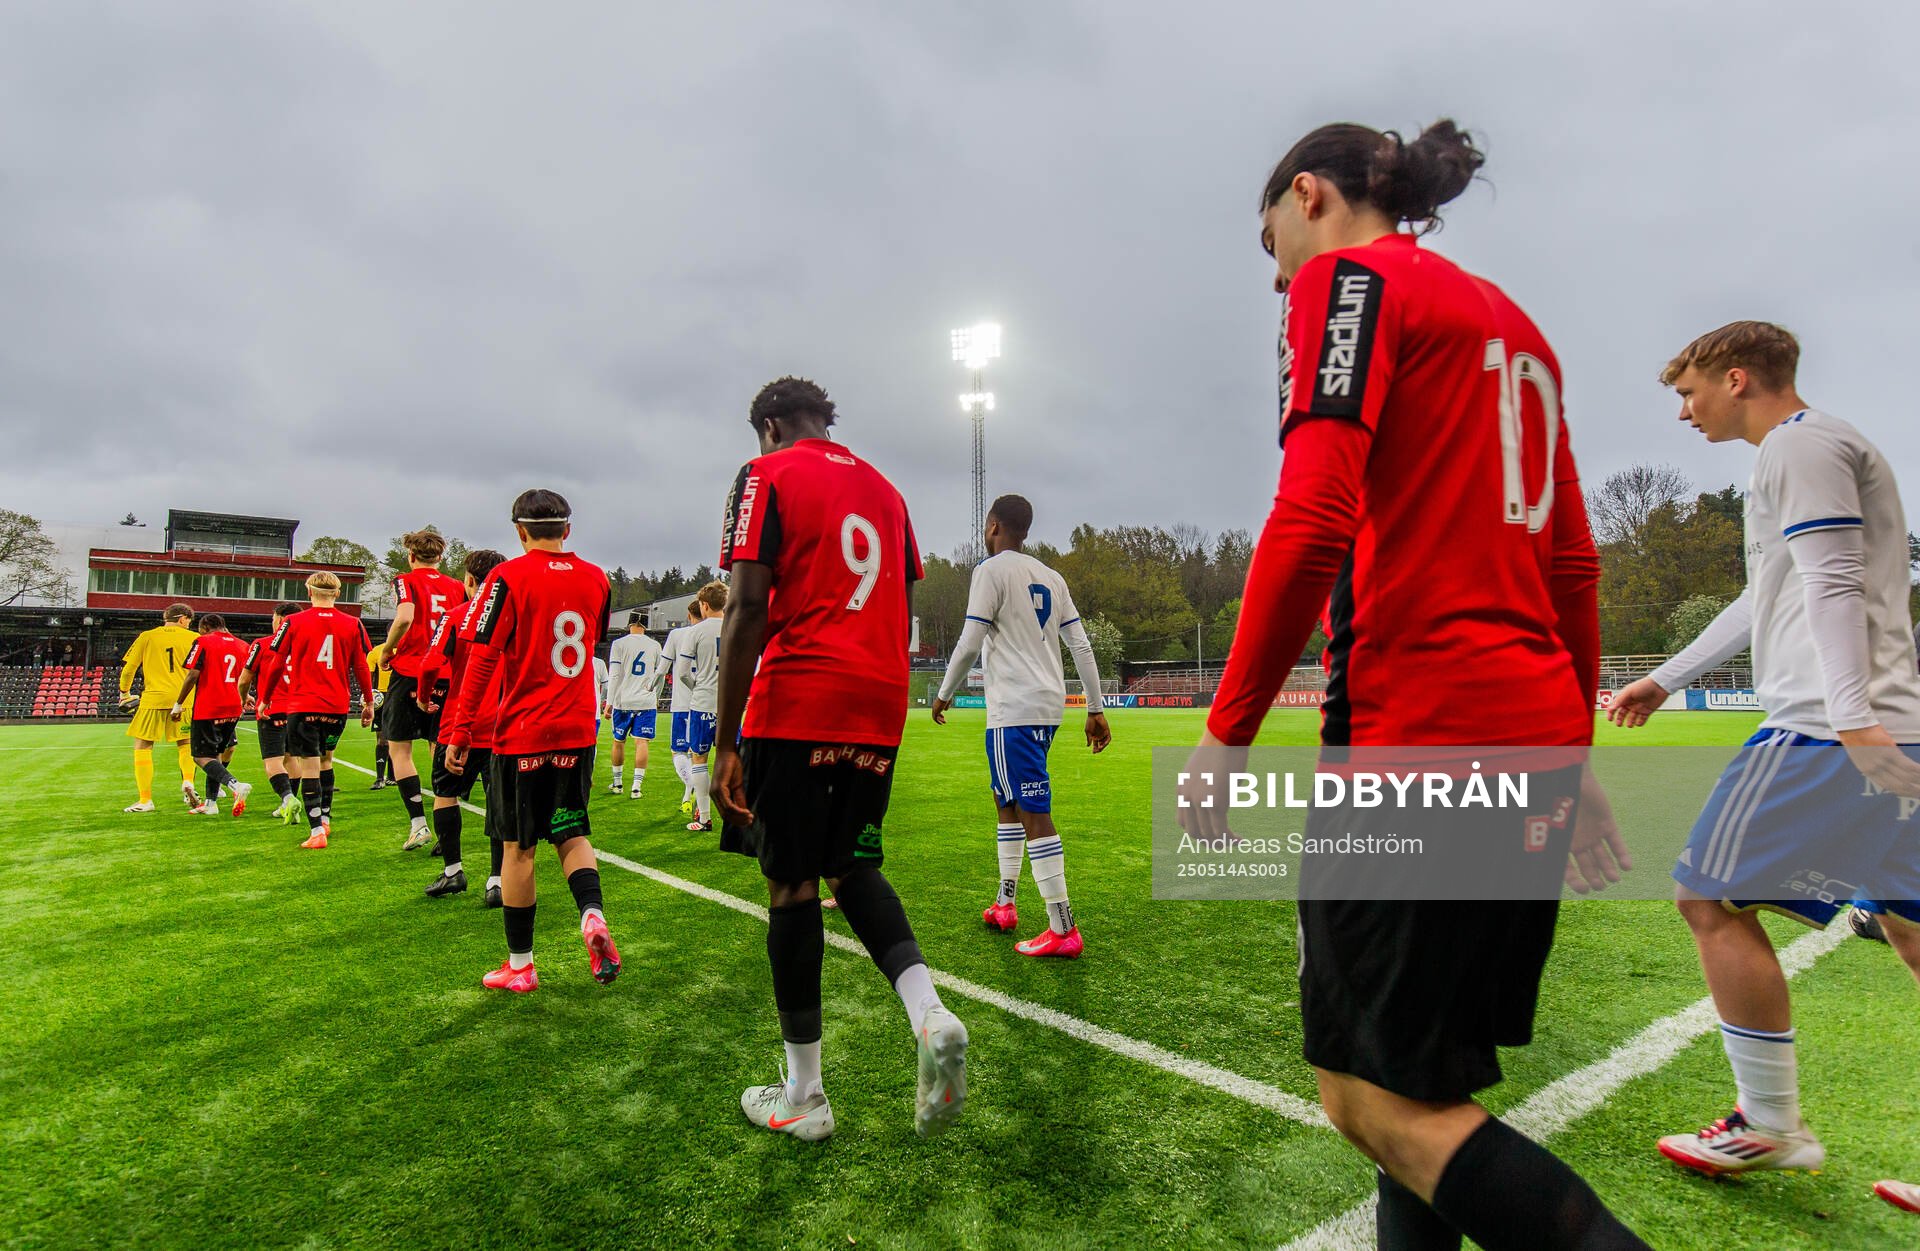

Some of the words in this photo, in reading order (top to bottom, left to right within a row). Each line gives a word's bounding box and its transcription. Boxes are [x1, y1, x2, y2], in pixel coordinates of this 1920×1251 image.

[1319, 275, 1370, 396] stadium
[1483, 338, 1561, 533] 10
[734, 476, 760, 546] stadium
[841, 513, 881, 611] 9
[476, 582, 500, 633] stadium
[165, 647, 174, 673] 1
[224, 654, 236, 683] 2
[316, 634, 334, 670] 4
[551, 610, 586, 678] 8
[631, 651, 646, 676] 6
